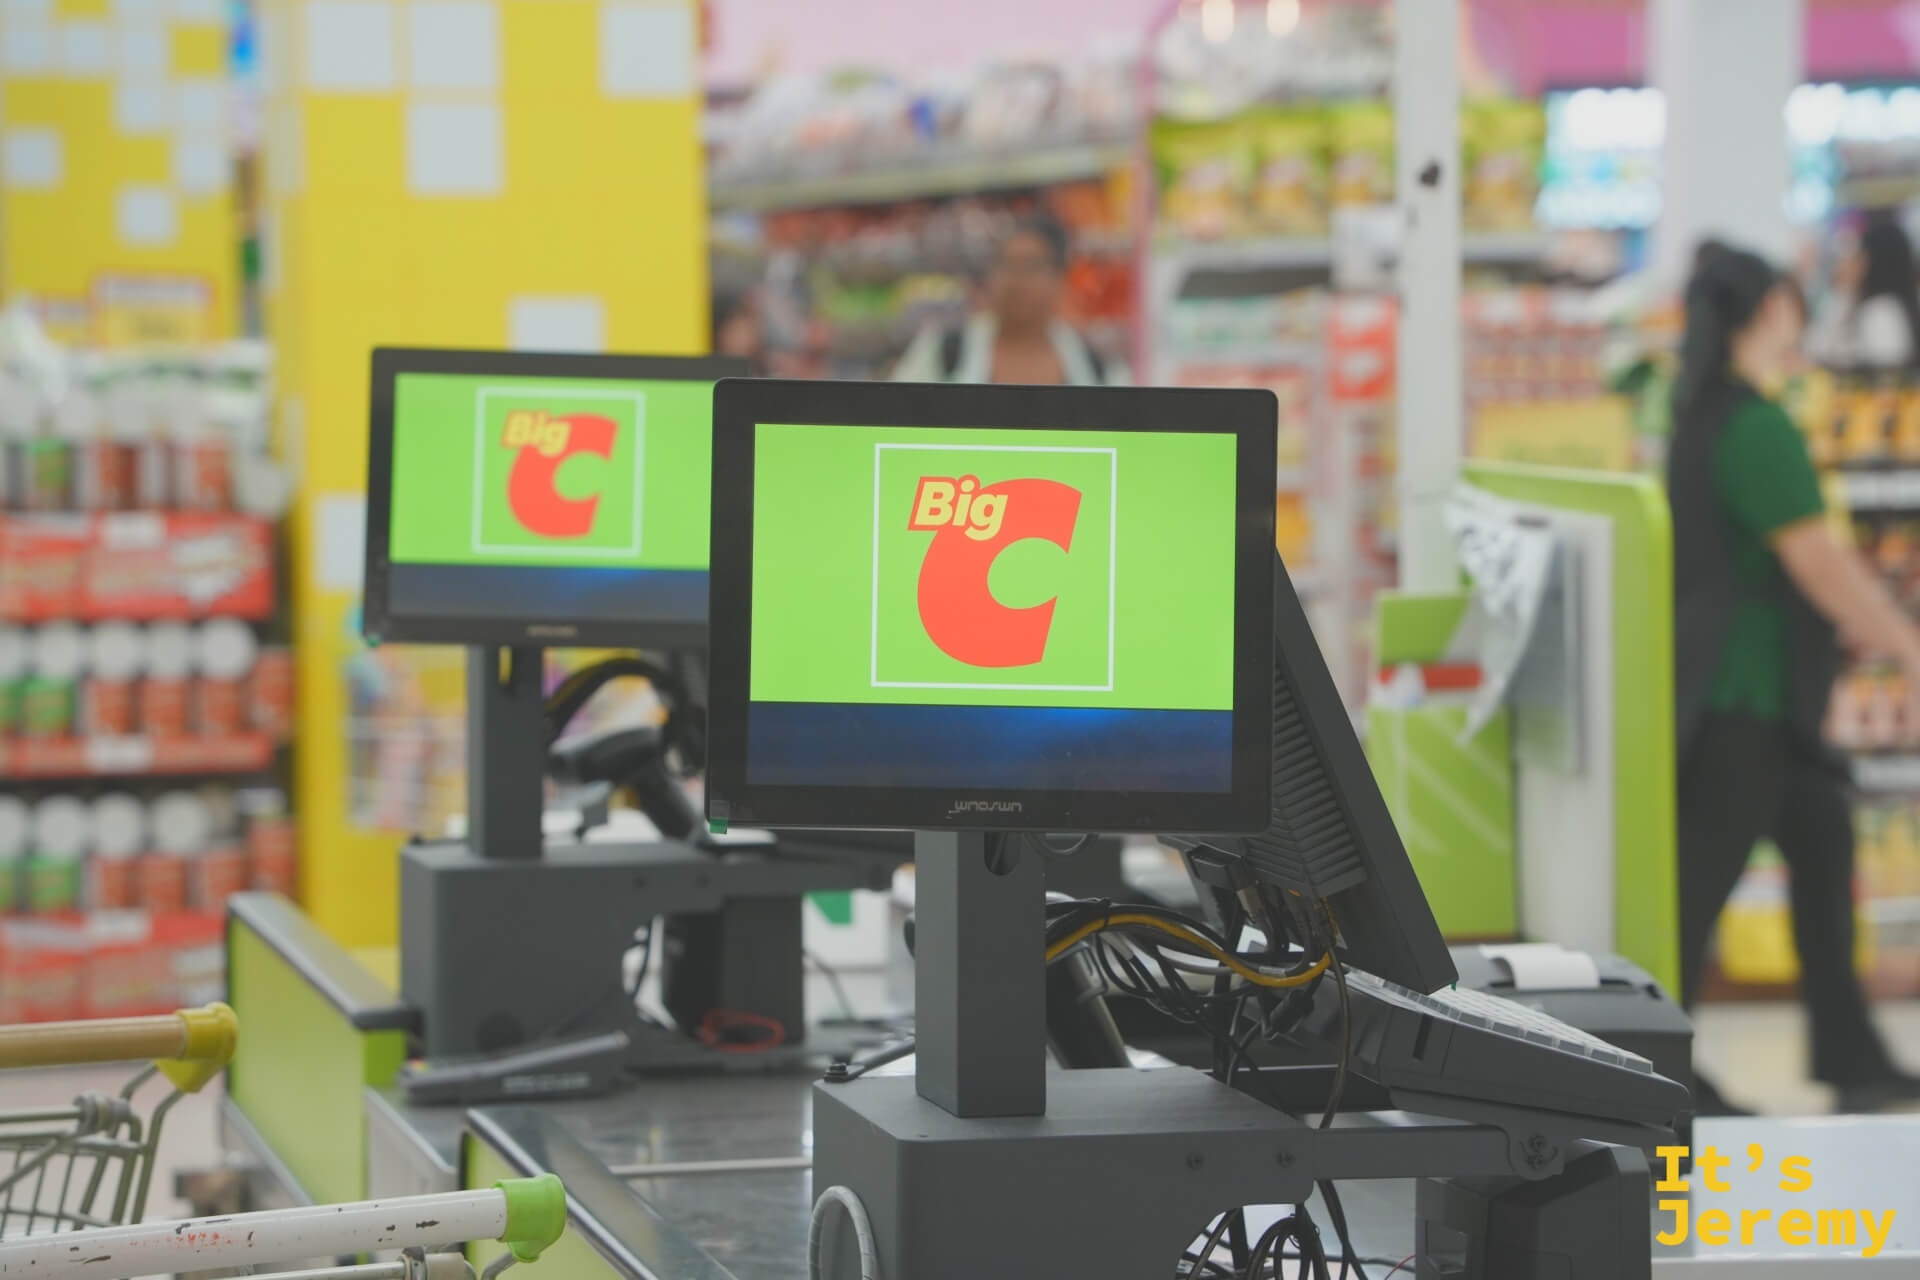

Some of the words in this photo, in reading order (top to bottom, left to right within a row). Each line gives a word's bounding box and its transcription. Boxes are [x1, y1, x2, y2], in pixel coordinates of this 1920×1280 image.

[504, 410, 571, 457] Big
[506, 412, 618, 538] C
[916, 478, 1008, 541] Big
[917, 478, 1082, 668] C
